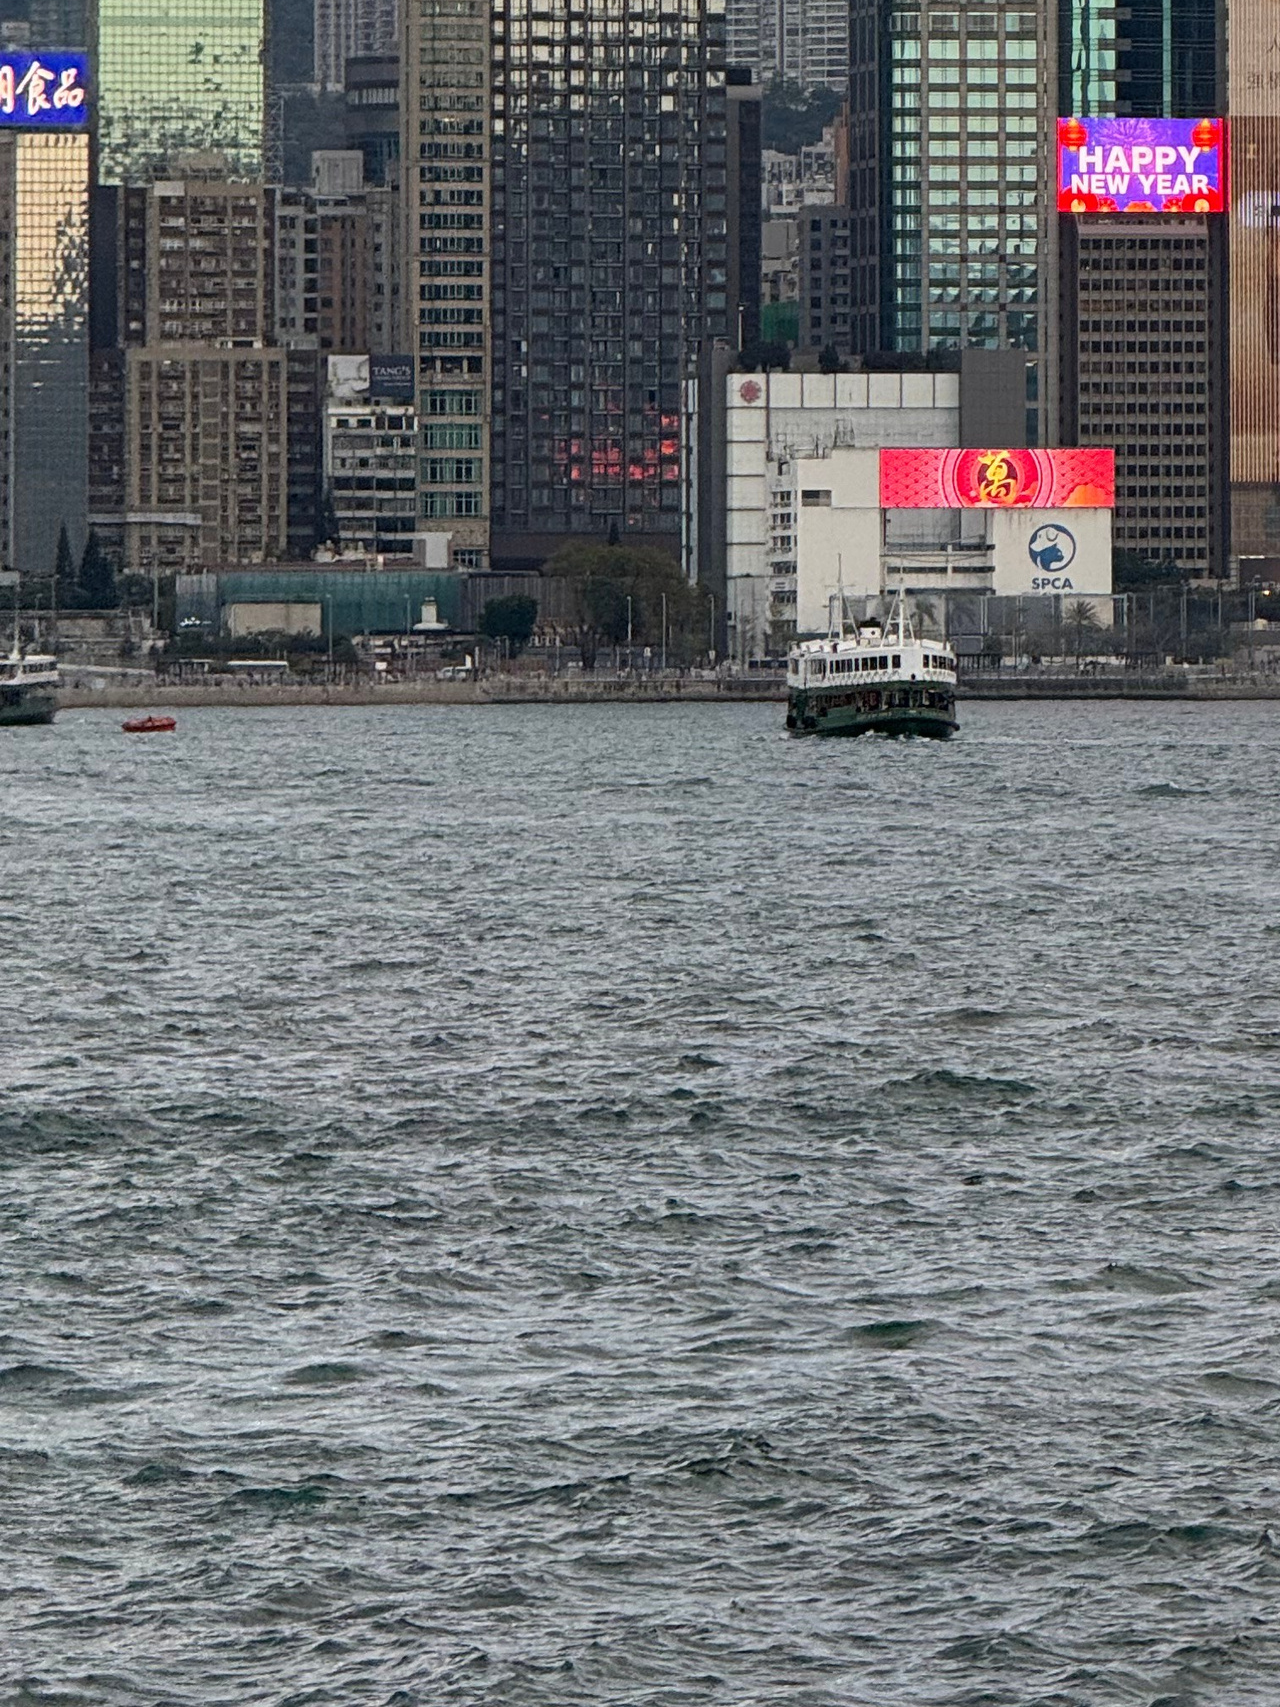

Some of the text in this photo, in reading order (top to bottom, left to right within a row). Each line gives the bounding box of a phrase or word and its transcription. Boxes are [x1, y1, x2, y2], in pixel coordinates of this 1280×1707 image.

[1079, 146, 1200, 173] HAPPY
[1071, 174, 1209, 194] NEW YEAR
[1032, 577, 1073, 589] SPCA
